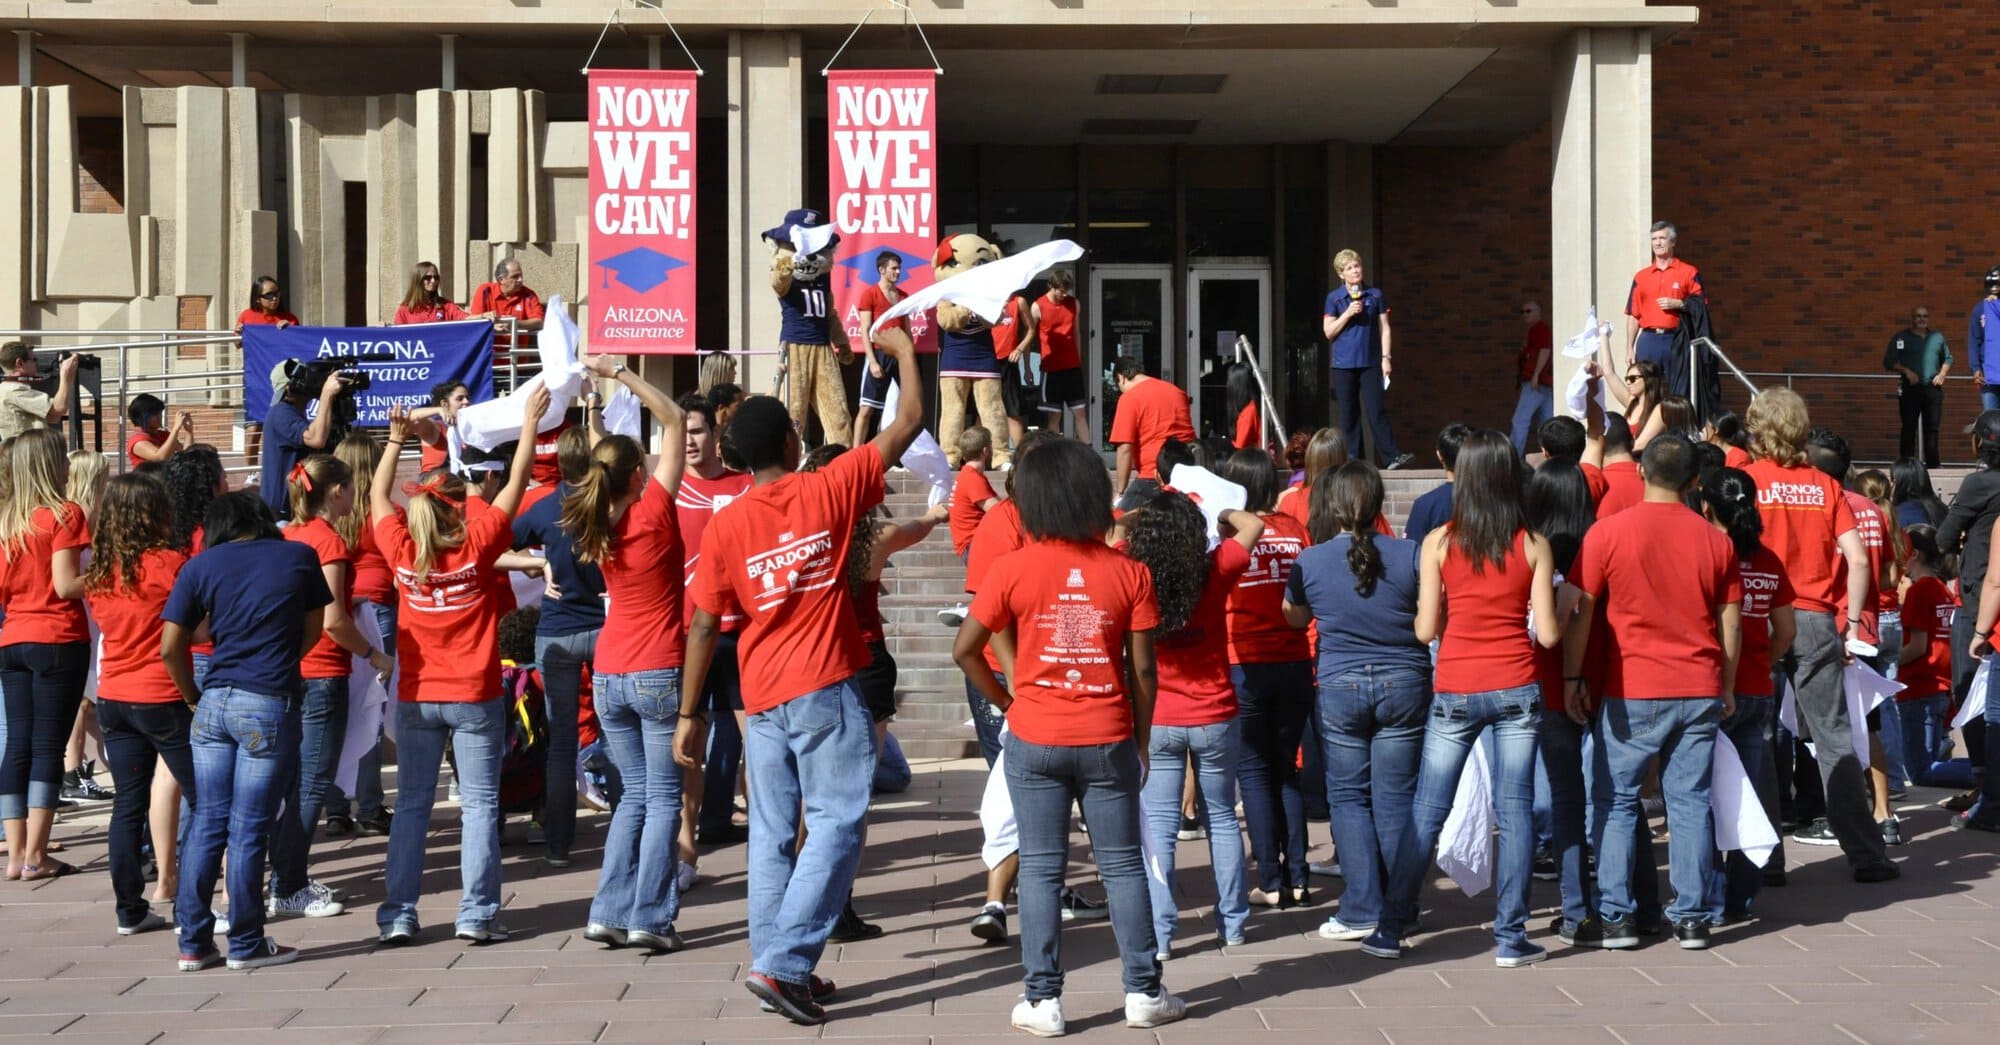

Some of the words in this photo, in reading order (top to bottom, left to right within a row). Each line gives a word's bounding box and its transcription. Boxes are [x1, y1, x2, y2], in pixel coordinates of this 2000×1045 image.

[597, 86, 690, 127] NOW
[836, 86, 929, 126] NOW
[593, 131, 691, 189] WE
[834, 130, 931, 189] WE
[594, 193, 691, 239] CAN!
[837, 192, 932, 238] CAN!
[604, 305, 685, 323] ARIZONA
[801, 289, 826, 318] 10
[604, 325, 685, 339] assurance
[317, 336, 431, 360] ARIZONA
[1758, 488, 1783, 504] UA
[747, 537, 832, 579] BEARDOWN
[1251, 543, 1302, 556] ARDOWN
[1058, 593, 1069, 601] WE
[1743, 578, 1779, 591] DOWN
